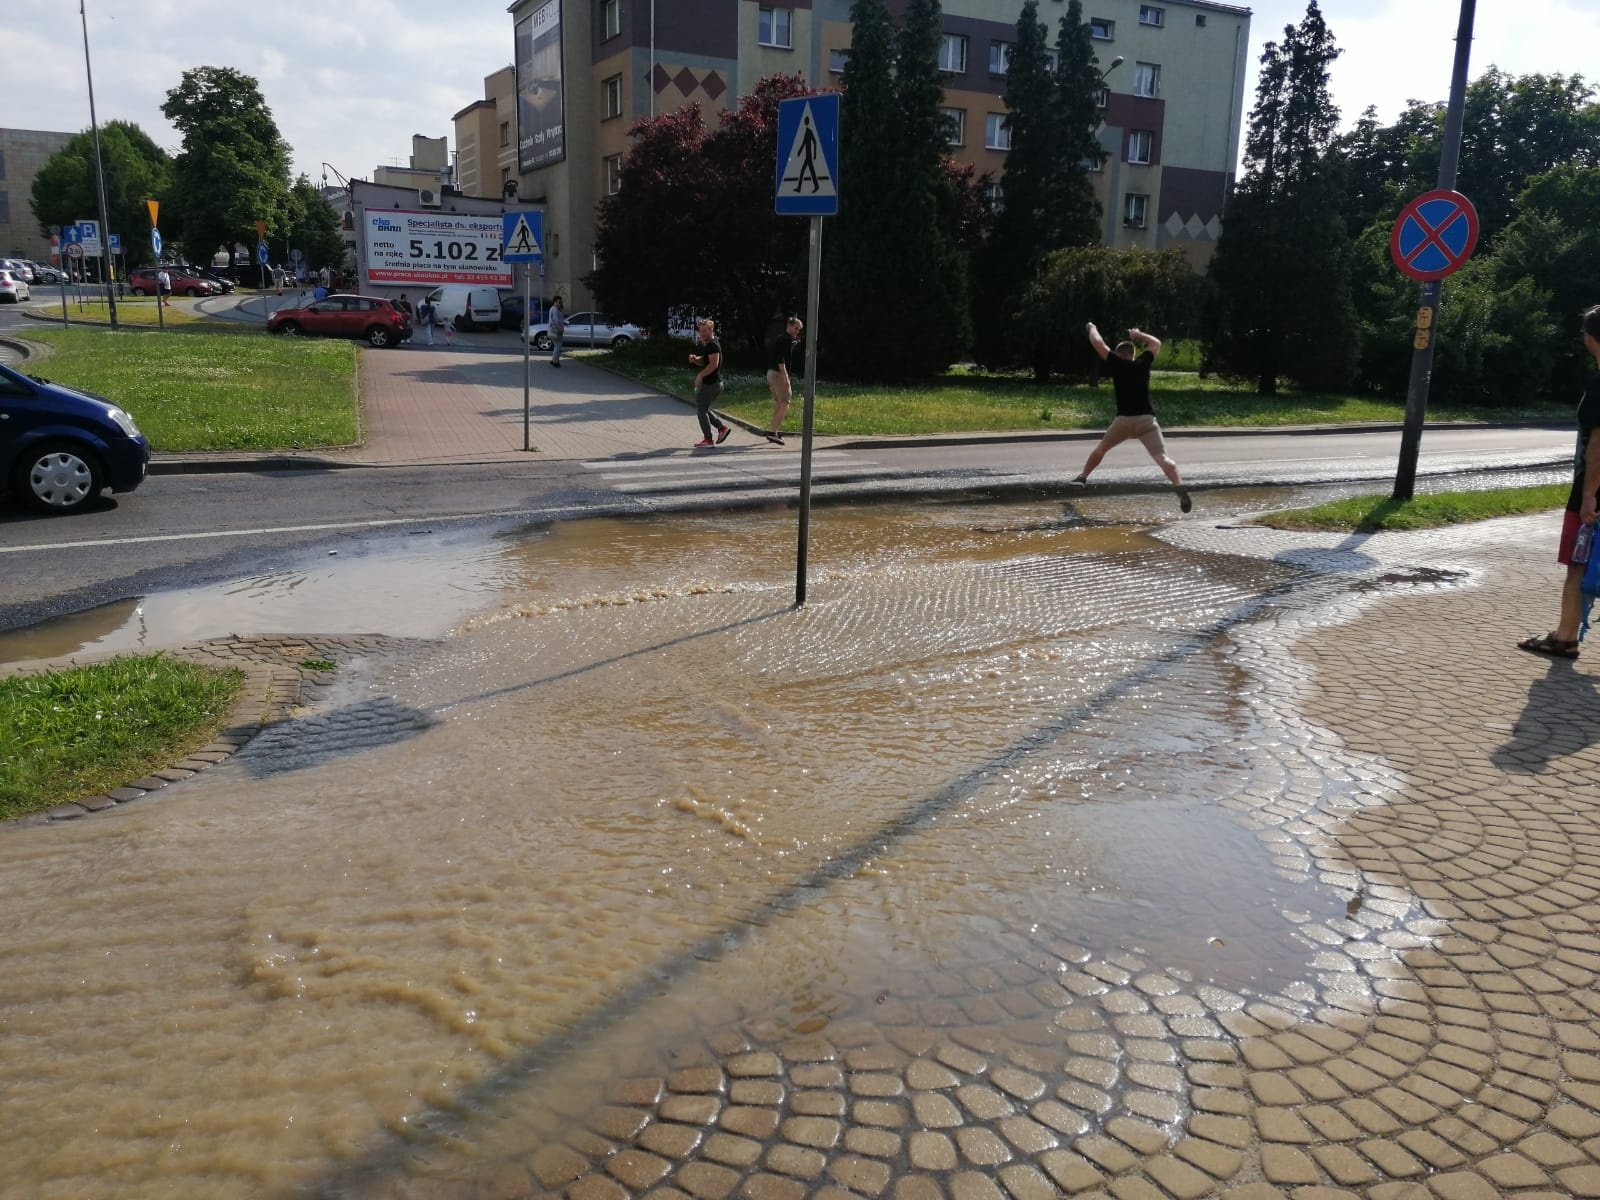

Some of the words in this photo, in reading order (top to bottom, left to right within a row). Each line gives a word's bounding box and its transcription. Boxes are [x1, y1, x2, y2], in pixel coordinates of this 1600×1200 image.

[407, 218, 452, 229] Specjalista
[455, 221, 467, 229] ds.
[373, 241, 395, 249] netto
[409, 239, 479, 261] 5.102
[384, 260, 411, 268] średnia
[412, 261, 432, 269] płaca
[443, 263, 457, 271] tym
